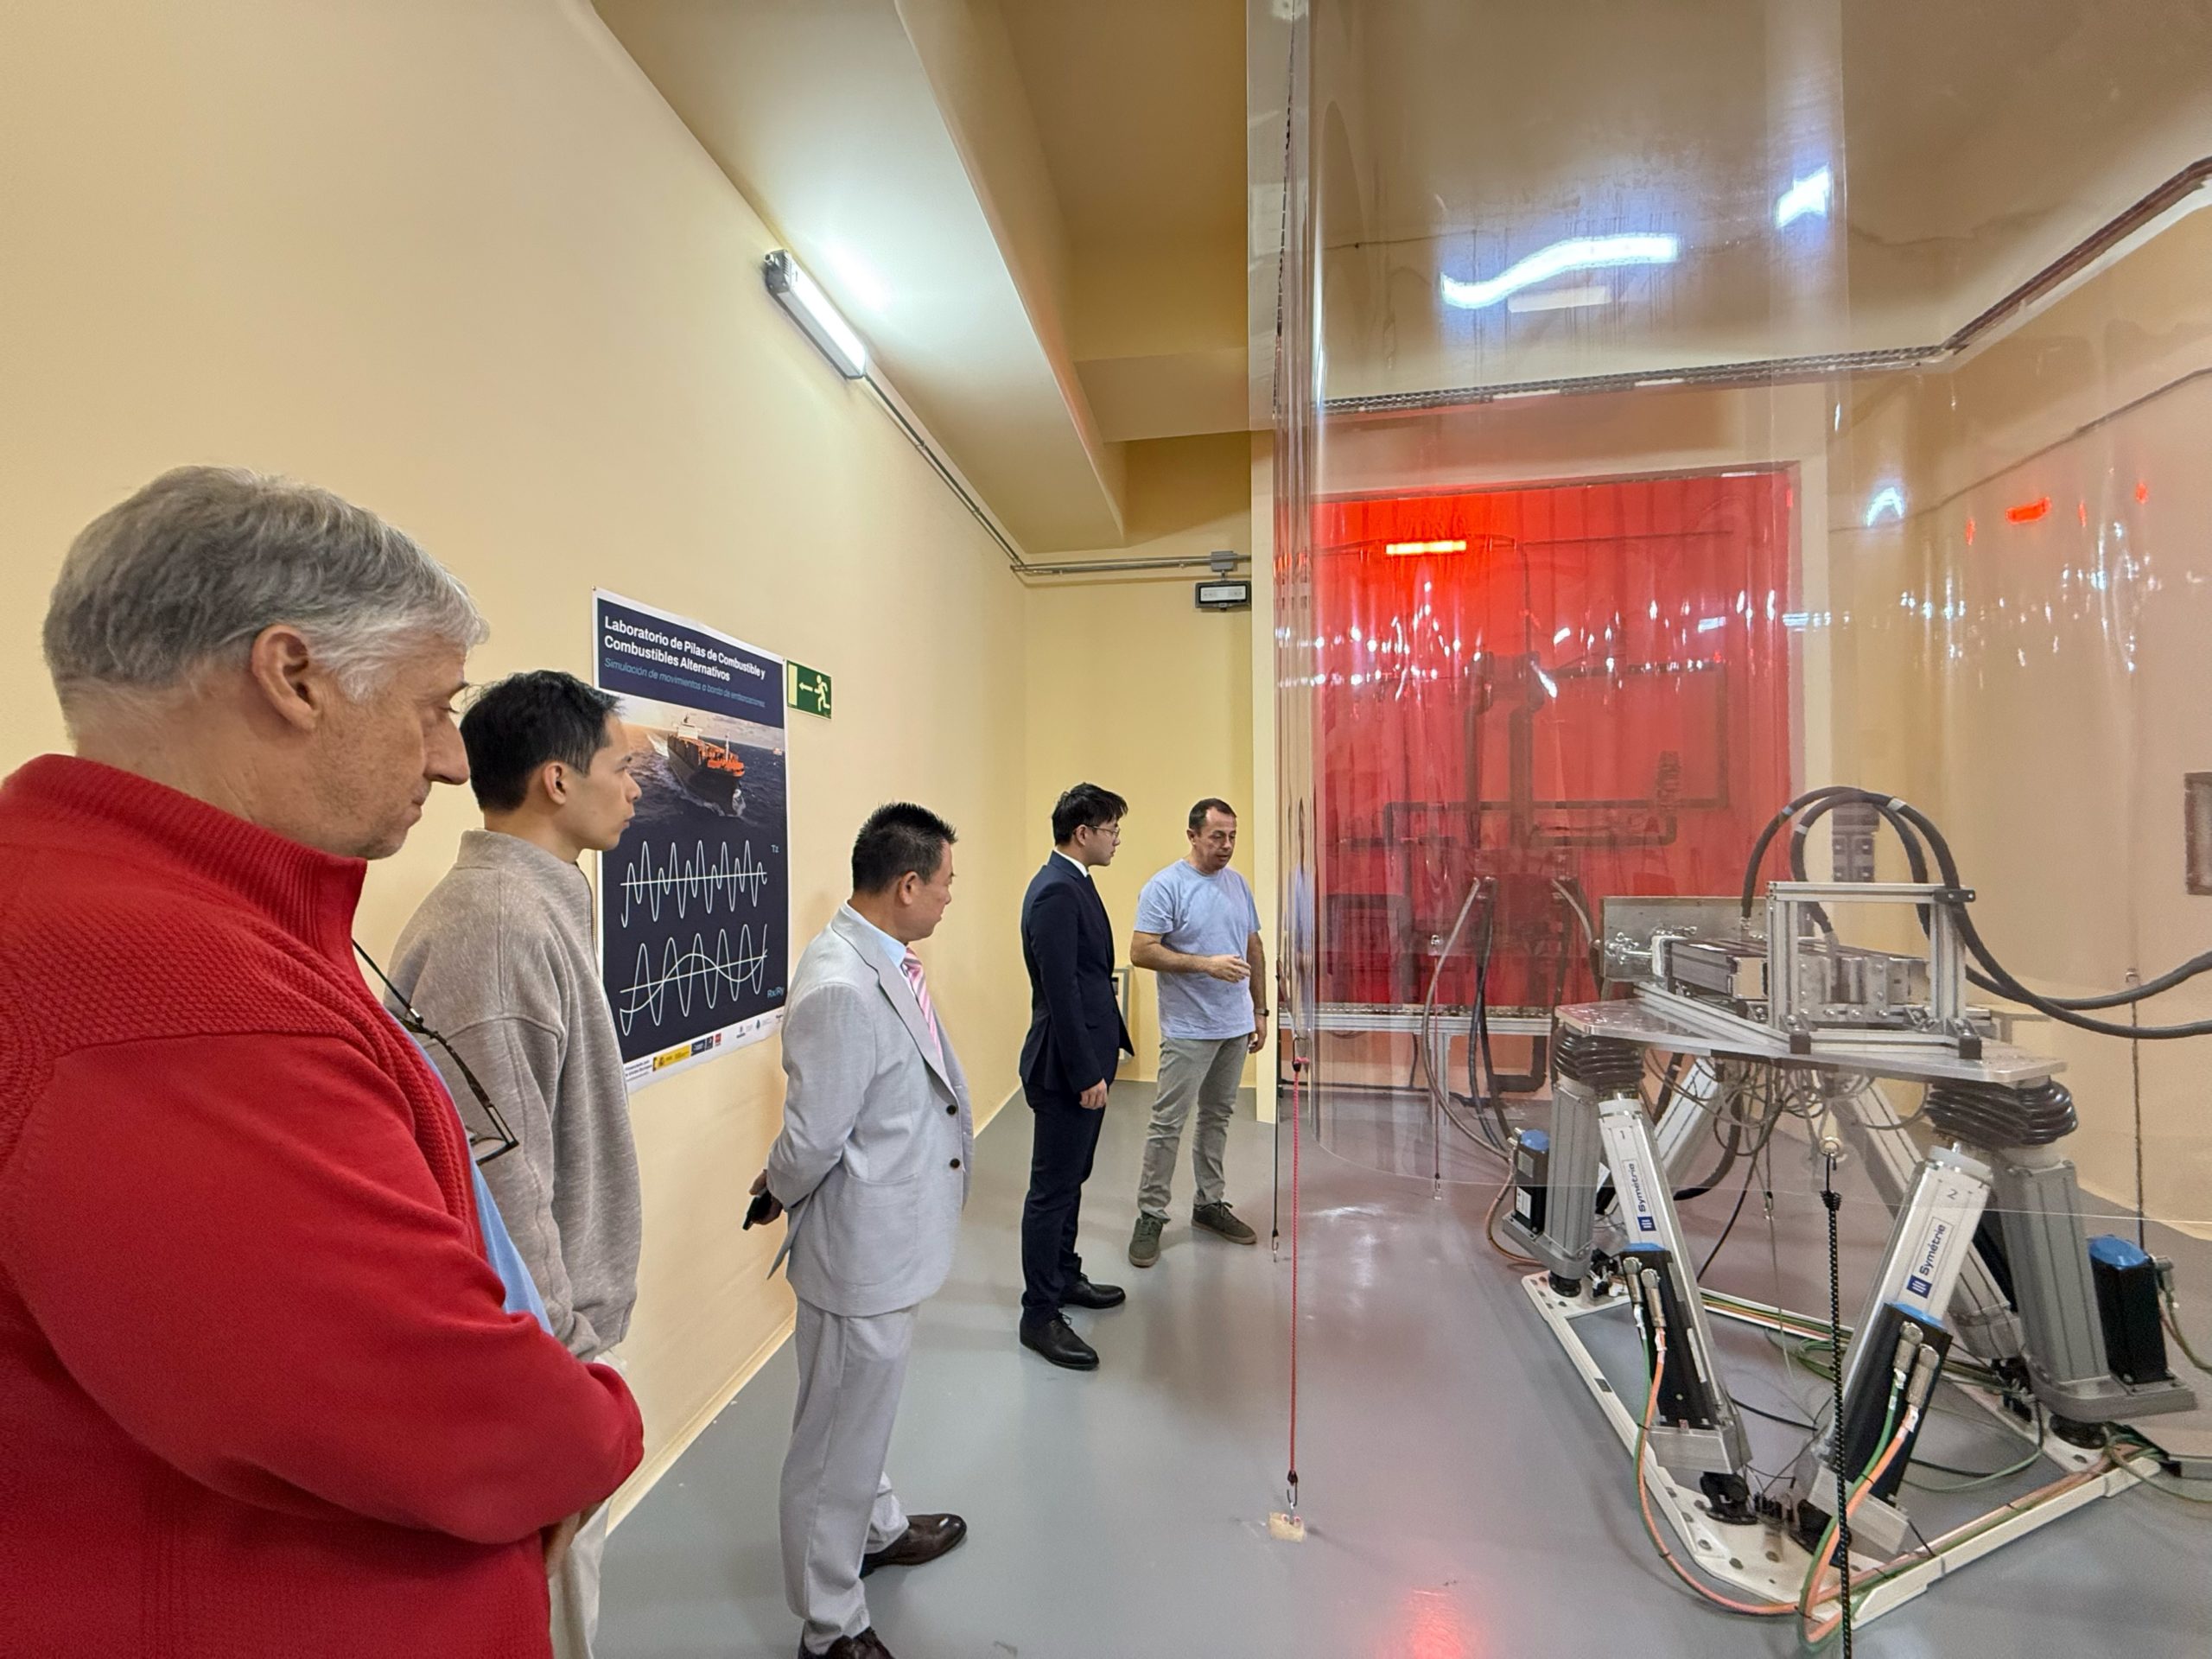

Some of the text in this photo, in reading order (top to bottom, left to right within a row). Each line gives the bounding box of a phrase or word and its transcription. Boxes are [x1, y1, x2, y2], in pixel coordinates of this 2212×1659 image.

[604, 635, 731, 682] Combustibles Alternativos
[605, 615, 766, 680] Laboratorio de Pilas de Combustible y
[604, 658, 647, 677] Simulación
[648, 669, 658, 679] de
[658, 673, 702, 690] movimientos
[1628, 1163, 1647, 1212] Symétrie
[1918, 1224, 1946, 1275] Symétrie
